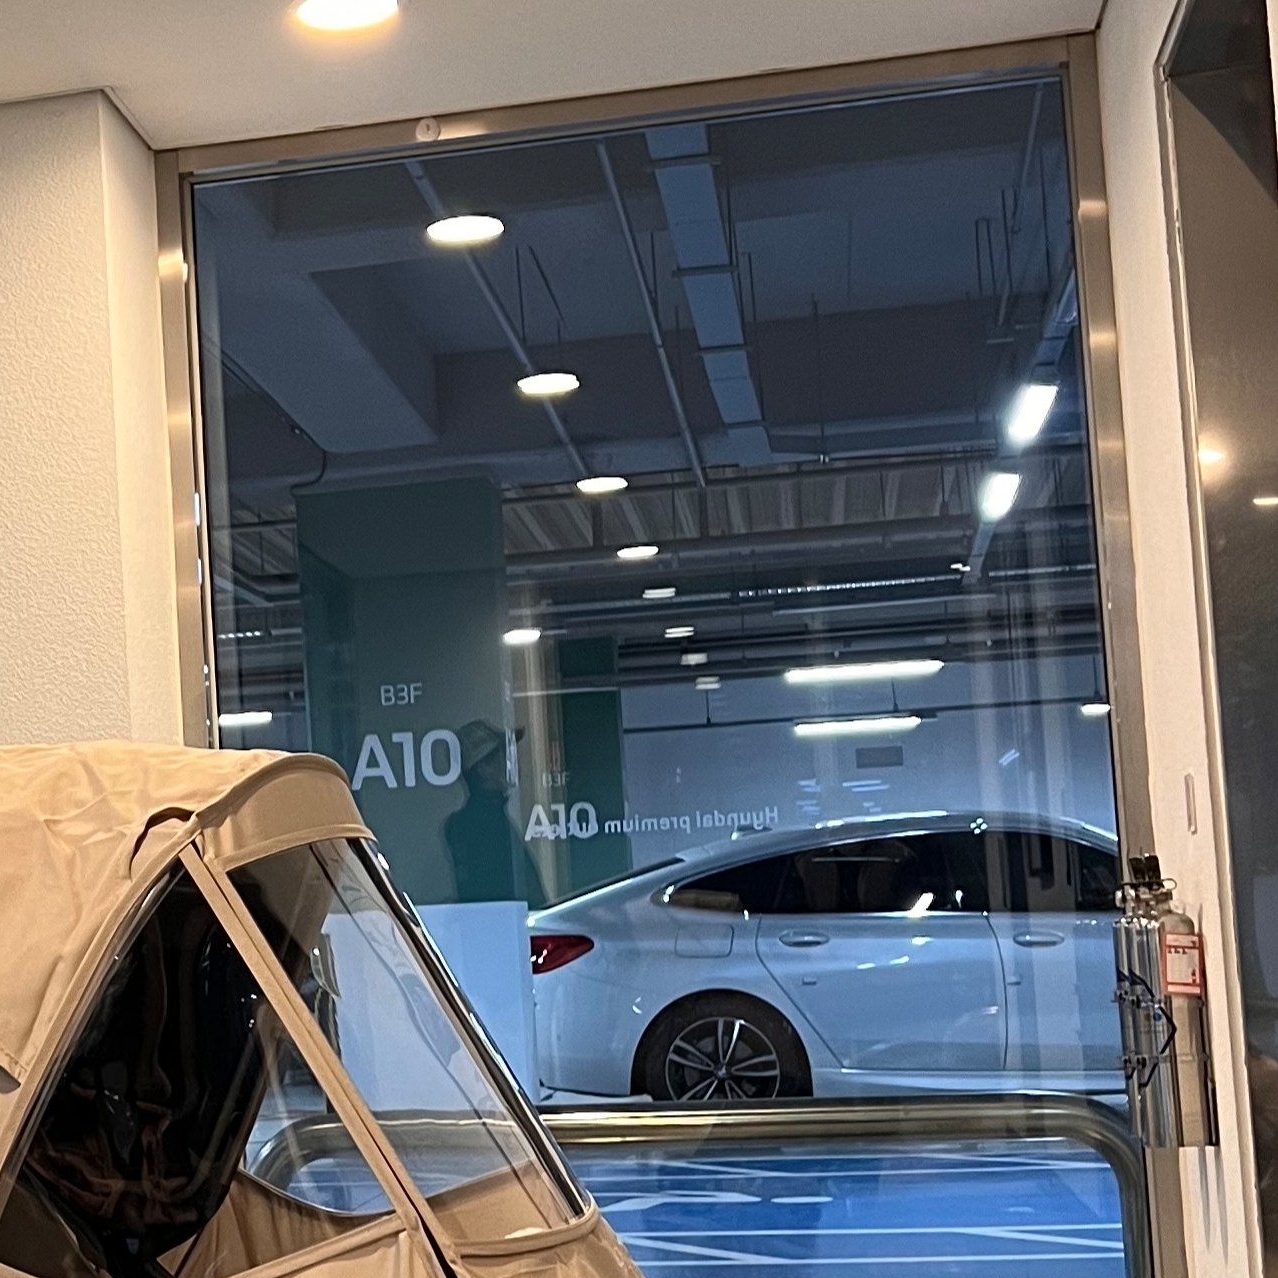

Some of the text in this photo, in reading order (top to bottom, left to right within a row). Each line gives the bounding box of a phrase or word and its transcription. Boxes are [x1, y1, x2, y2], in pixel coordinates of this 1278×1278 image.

[380, 682, 422, 706] B3F
[351, 728, 462, 791] A10
[524, 801, 597, 842] A10
